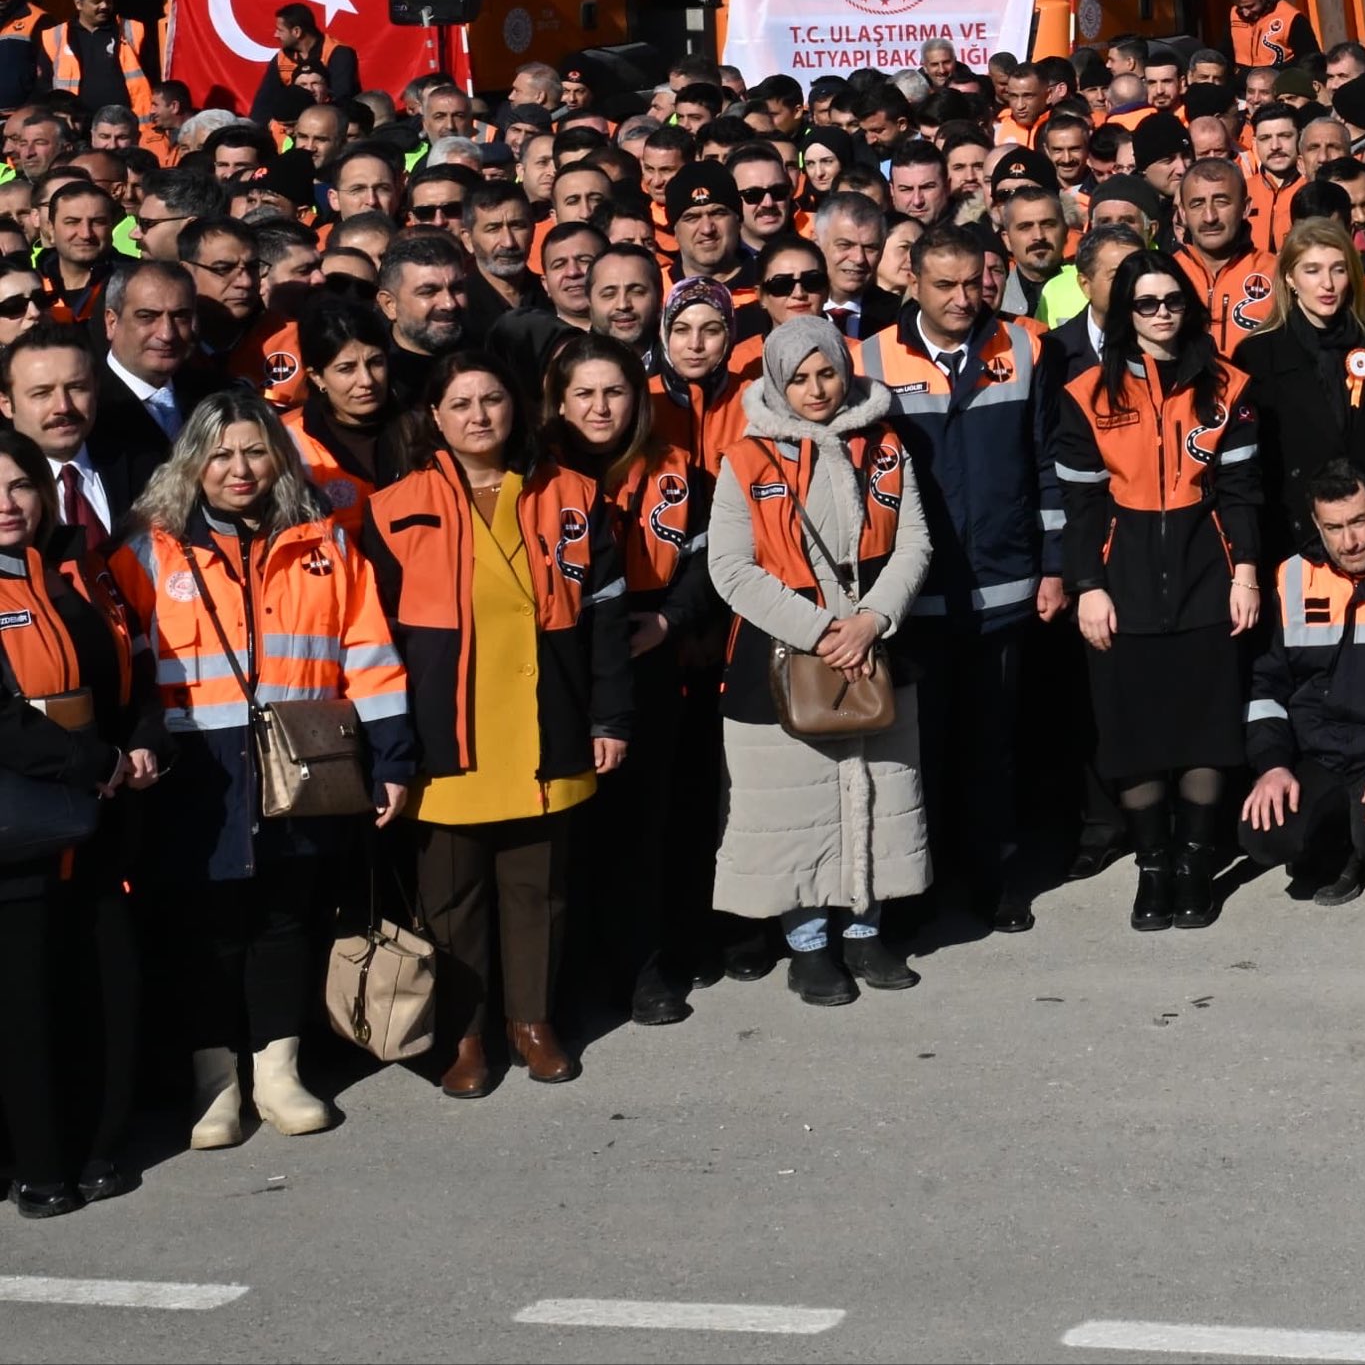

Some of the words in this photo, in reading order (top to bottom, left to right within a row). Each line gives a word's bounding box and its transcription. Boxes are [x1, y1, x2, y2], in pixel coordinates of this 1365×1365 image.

[789, 25, 825, 44] T.C.
[830, 24, 953, 48] ULAŞTIRMA
[959, 22, 988, 41] VE
[792, 49, 871, 69] ALTYAPI
[877, 44, 989, 67] BAKIĞI
